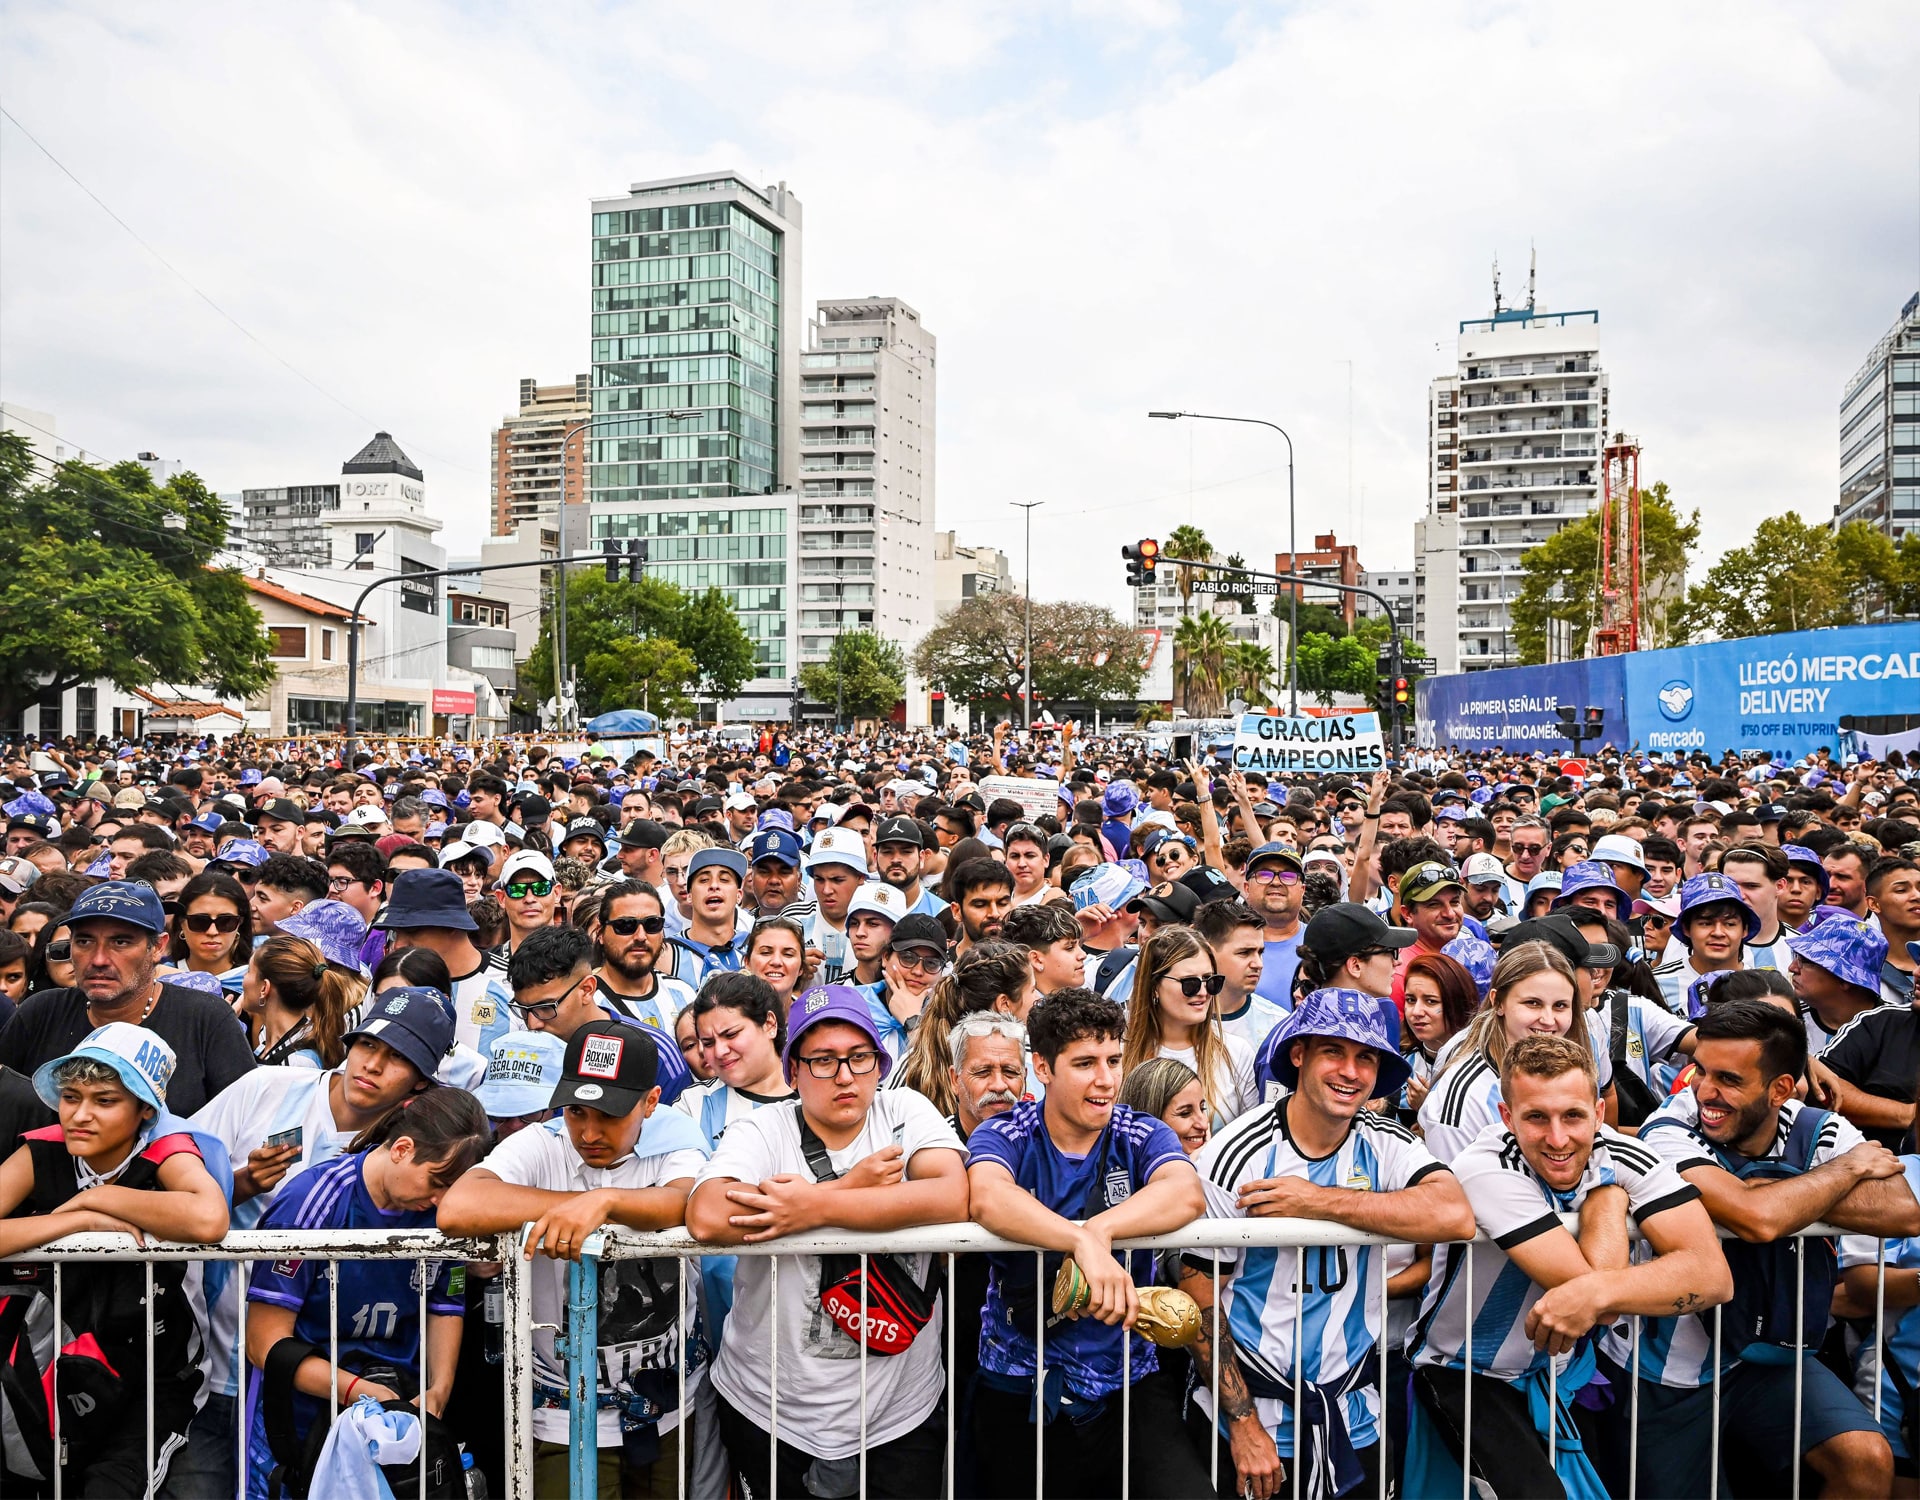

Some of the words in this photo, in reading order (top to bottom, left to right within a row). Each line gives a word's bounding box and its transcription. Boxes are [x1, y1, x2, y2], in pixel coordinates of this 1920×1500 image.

[353, 482, 388, 496] ORT
[1192, 582, 1229, 593] PABLO
[1232, 583, 1278, 594] RICHIERI
[1740, 653, 1798, 686] LLEGÓ
[1460, 703, 1470, 715] LA
[1470, 699, 1507, 715] PRIMERA
[1509, 695, 1542, 714] SEÑAL
[1544, 696, 1558, 711] DE
[1740, 687, 1831, 715] DELIVERY
[1257, 716, 1357, 743] GRACIAS
[1449, 725, 1481, 740] NOTICIAS
[1483, 726, 1494, 740] DE
[1649, 727, 1705, 747] mercado
[1741, 723, 1760, 736] $750
[1761, 723, 1780, 735] OFF
[1782, 723, 1796, 736] EN
[1232, 744, 1383, 769] CAMPEONES
[477, 1006, 492, 1018] AFA
[586, 1040, 620, 1052] EVERLAST
[494, 1049, 505, 1060] LA
[585, 1049, 616, 1066] BOXING
[490, 1060, 543, 1076] ESCALONETA
[587, 1061, 609, 1069] ACADEMY
[511, 1072, 522, 1081] DEL
[1111, 1182, 1129, 1198] AFA
[350, 1302, 398, 1339] 10
[827, 1297, 899, 1342] SPORTS
